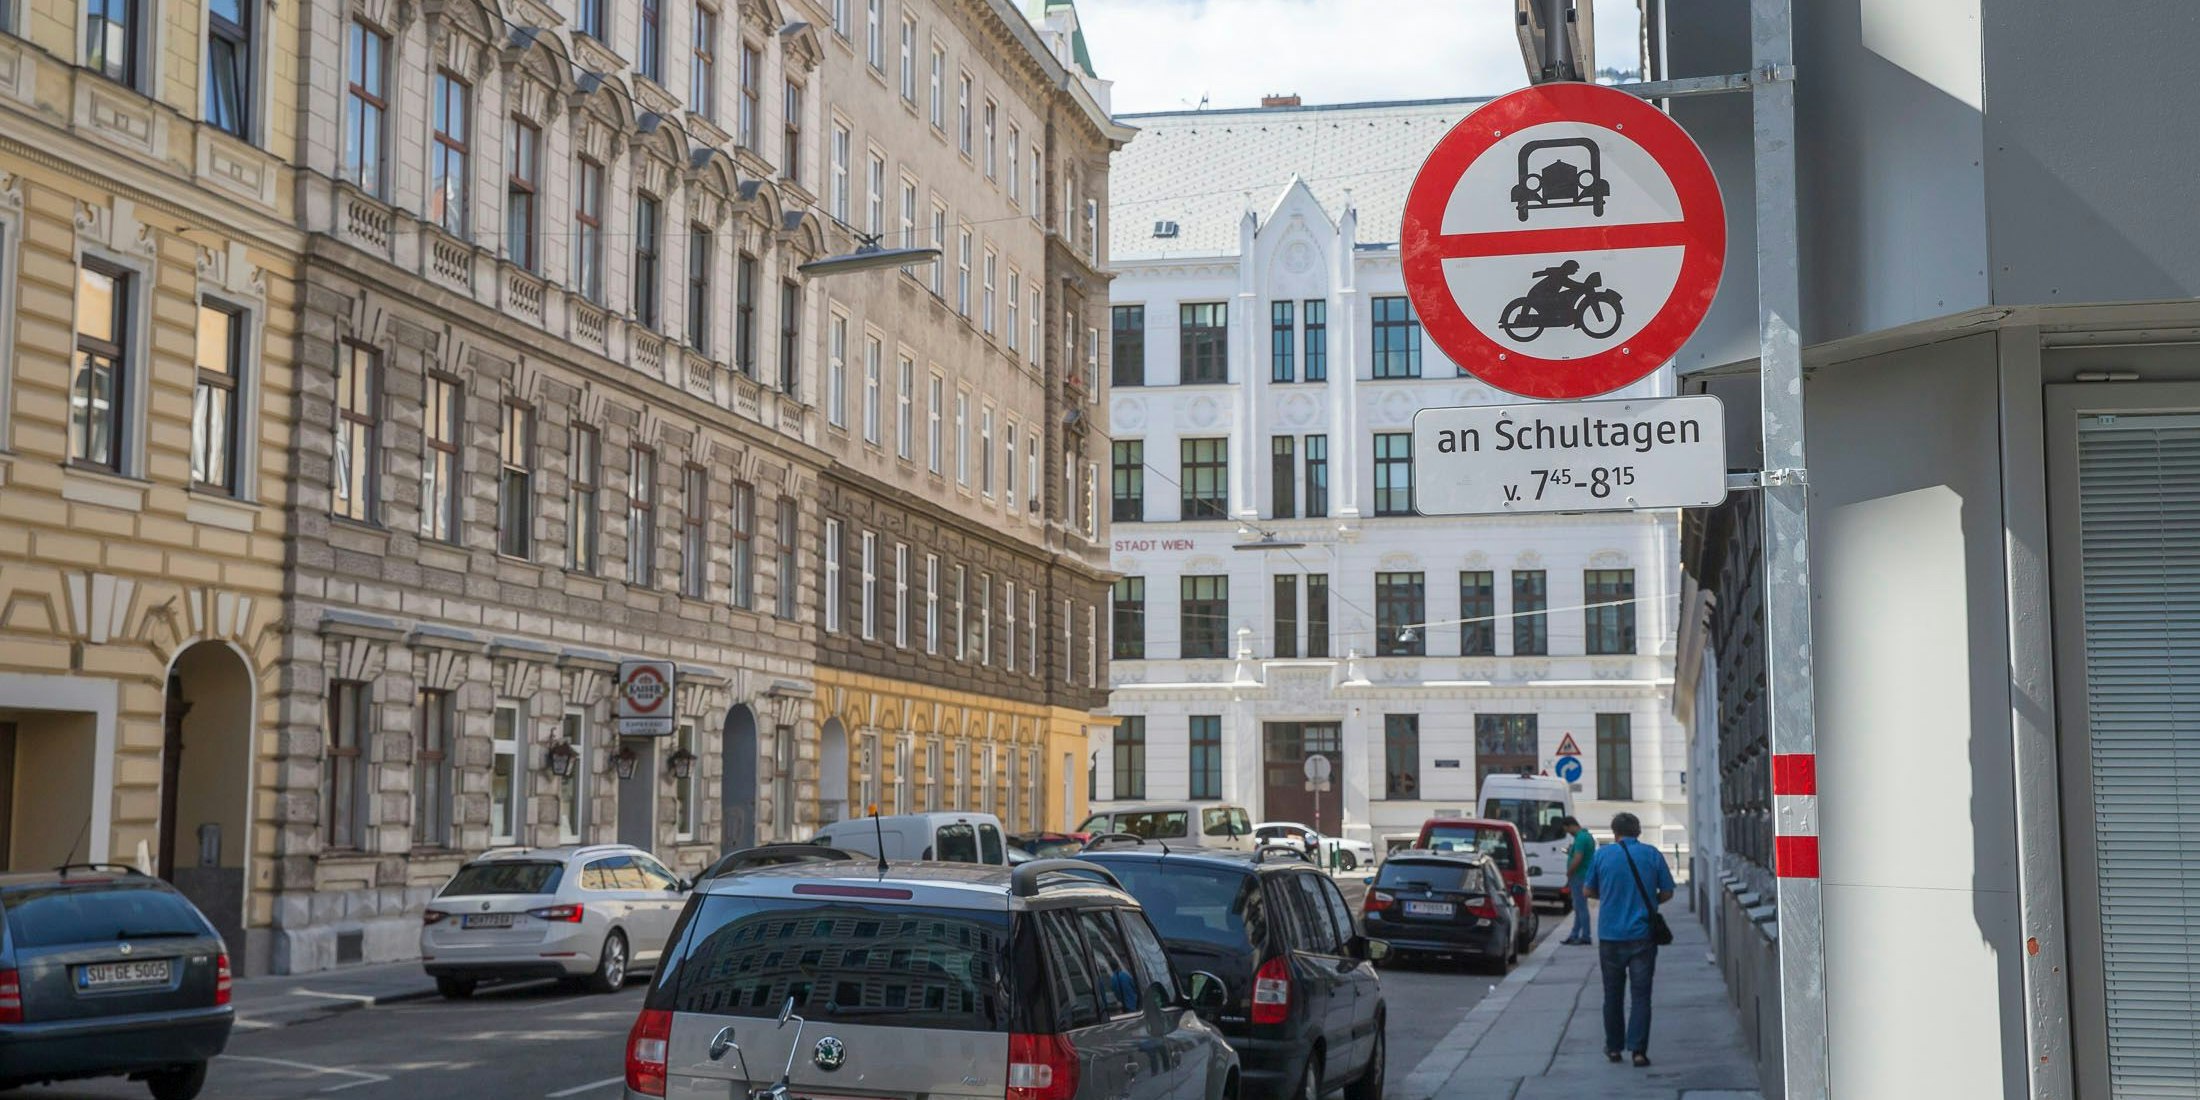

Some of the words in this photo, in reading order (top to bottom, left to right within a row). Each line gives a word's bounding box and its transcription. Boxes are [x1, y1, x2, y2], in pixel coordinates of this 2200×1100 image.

[1438, 428, 1480, 453] an
[1495, 417, 1700, 453] Schultagen
[1503, 484, 1521, 501] v.
[1115, 540, 1157, 551] STADT
[1161, 539, 1194, 550] WIEN
[630, 684, 661, 695] KAISER
[88, 965, 105, 982] SU
[115, 963, 133, 980] GE
[135, 962, 167, 979] 5005
